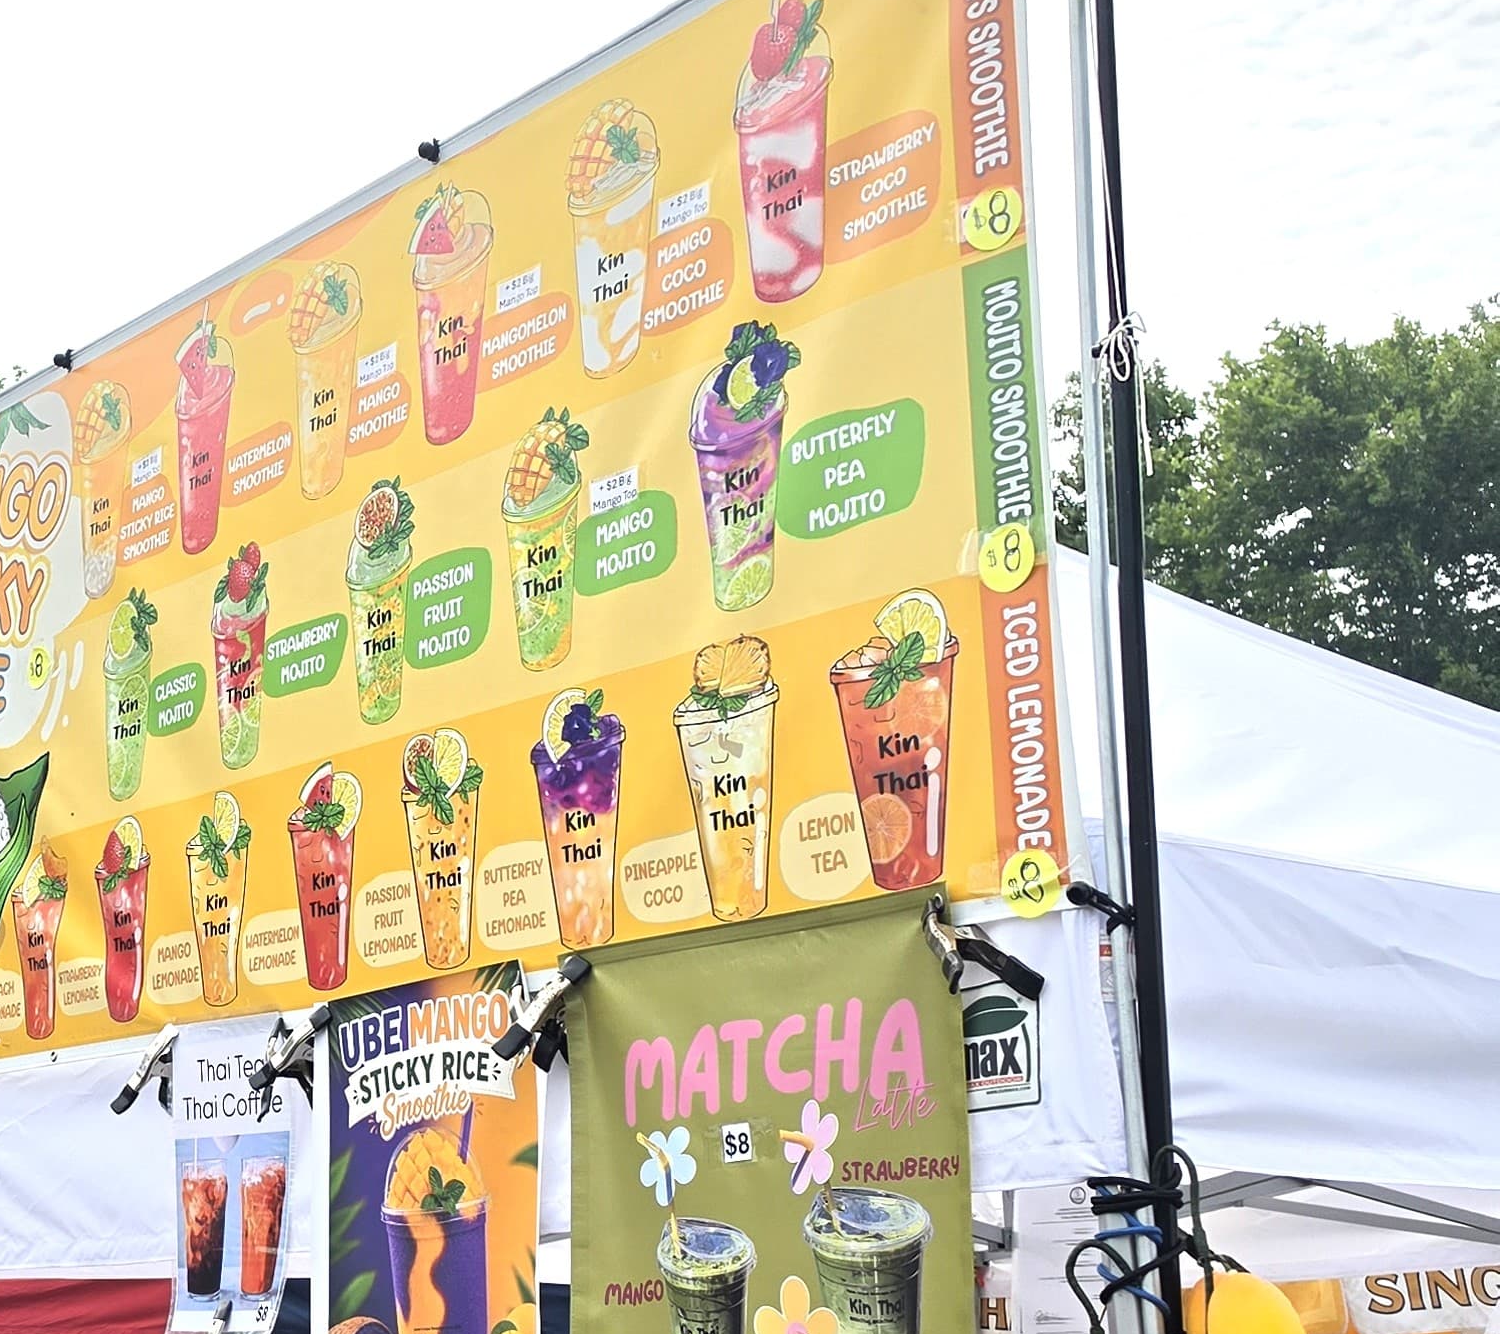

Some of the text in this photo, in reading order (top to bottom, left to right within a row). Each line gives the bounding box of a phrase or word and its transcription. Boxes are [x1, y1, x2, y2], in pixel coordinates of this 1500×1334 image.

[966, 21, 1010, 177] SMOOTHIE
[829, 121, 936, 186] STRAWBERRY
[766, 166, 797, 193] Kin
[860, 166, 907, 204] COCO
[762, 188, 804, 222] Thai
[843, 188, 927, 242] SMOOTHIE
[971, 190, 1011, 235] $8
[657, 226, 712, 267] MANGO
[597, 251, 625, 276] Kin
[661, 258, 706, 292] COCO
[592, 273, 629, 304] Thai
[643, 281, 725, 330] SMOOTHIE
[437, 315, 464, 339] Kin
[482, 302, 567, 353] MANGOMELON
[433, 337, 467, 366] Thai
[491, 336, 556, 380] SMOOTHIE
[312, 387, 335, 408] Kin
[358, 382, 400, 414] MANGO
[982, 277, 1034, 526] MOJITO SMOOTHIE
[309, 407, 337, 433] Thai
[348, 404, 408, 443] SMOOTHIE
[790, 409, 896, 465] BUTTERFLY
[192, 450, 210, 468] Kin
[227, 431, 292, 473] WATERMELON
[188, 473, 213, 491] Thai
[232, 460, 285, 496] SMOOTHIE
[606, 473, 633, 492] $2 Big
[724, 463, 760, 497] Kin
[823, 459, 866, 492] PEA
[91, 496, 110, 515] Kin
[131, 486, 165, 513] MANGO
[593, 488, 638, 512] Mango Top
[719, 494, 765, 527] Thai
[807, 491, 886, 533] MOJITO
[89, 516, 112, 537] Thai
[119, 502, 176, 540] STICKY RICE
[595, 507, 654, 547] MANGO
[123, 528, 170, 560] SMOOTHIE
[526, 544, 557, 569] Kin
[983, 529, 1023, 575] $8
[595, 540, 656, 580] MOJITO
[412, 562, 474, 600] PASSION
[522, 570, 563, 599] Thai
[366, 607, 392, 630] Kin
[423, 597, 465, 628] FRUIT
[267, 619, 340, 661] STRAWBERRY
[363, 632, 397, 657] Thai
[417, 626, 470, 660] MOJITO
[229, 657, 251, 677] Kin
[280, 654, 325, 685] MOJITO
[154, 671, 197, 703] CLASSIC
[225, 681, 255, 704] Thai
[117, 697, 139, 716] Kin
[157, 702, 194, 729] MOJITO
[113, 719, 141, 741] Thai
[999, 600, 1054, 851] ICED LEMONADE
[877, 732, 921, 759] Kin
[713, 773, 747, 799] Kin
[872, 763, 932, 796] Thai
[564, 811, 595, 833] Kin
[709, 804, 756, 832] Thai
[798, 812, 856, 842] LEMON
[430, 840, 456, 861] Kin
[561, 839, 602, 864] Thai
[811, 847, 848, 874] TEA
[426, 867, 462, 890] Thai
[483, 858, 544, 885] BUTTERFLY
[624, 852, 698, 883] PINEAPPLE
[312, 872, 336, 892] Kin
[365, 883, 411, 905] PASSION
[205, 894, 228, 912] Kin
[309, 897, 341, 918] Thai
[502, 890, 526, 907] PEA
[643, 885, 683, 908] COCO
[113, 911, 132, 928] Kin
[202, 918, 231, 939] Thai
[374, 911, 404, 930] FRUIT
[485, 912, 546, 938] LEMONADE
[27, 931, 45, 948] Kin
[113, 935, 136, 953] Thai
[245, 925, 300, 949] WATERMELON
[363, 933, 417, 958] LEMONADE
[27, 956, 49, 972] Thai
[157, 943, 192, 963] MANGO
[248, 950, 297, 973] LEMONADE
[58, 963, 104, 985] STRAWBERRY
[152, 966, 200, 991] LEMONADE
[62, 985, 100, 1006] LEMONADE
[340, 990, 508, 1067] UBE MANGO
[197, 1056, 233, 1084] Thai
[624, 997, 926, 1127] MATCHA
[359, 1051, 490, 1105] STICKY RICE
[183, 1091, 283, 1122] Thai Coffe
[381, 1083, 471, 1140] Smoothie
[851, 1073, 939, 1133] Latte
[723, 1130, 750, 1158] $8
[841, 1154, 960, 1184] STRAWBERRY
[604, 1279, 664, 1307] MANGO
[849, 1297, 872, 1316] Kin
[256, 1305, 269, 1323] $8
